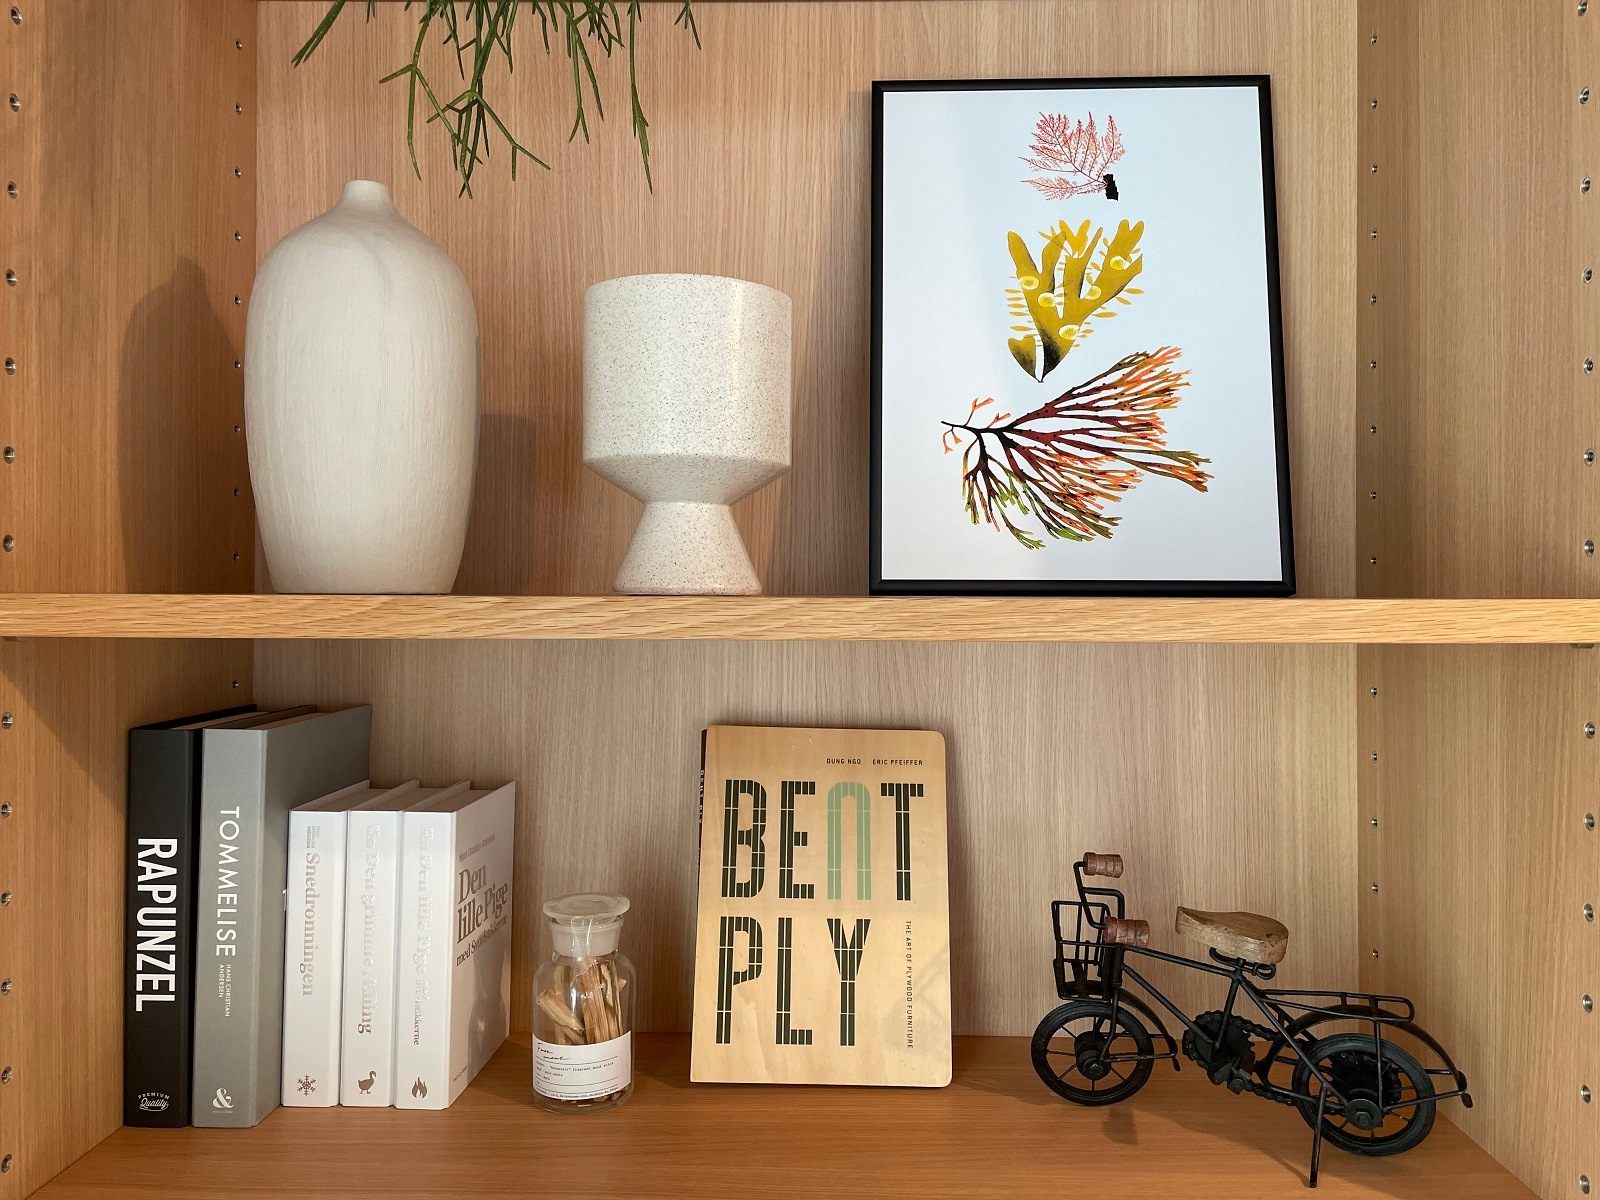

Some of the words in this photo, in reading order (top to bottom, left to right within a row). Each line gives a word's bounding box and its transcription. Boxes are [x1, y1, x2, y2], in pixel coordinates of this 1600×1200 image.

[722, 780, 924, 900] BENT
[216, 806, 240, 956] TOMMELISE
[458, 865, 486, 904] Den
[136, 839, 177, 1012] RAPUNZEL
[300, 852, 320, 996] Snedronningen
[457, 898, 483, 944] lille
[484, 883, 508, 922] Pige
[456, 943, 470, 966] med
[716, 916, 871, 1046] PLY
[906, 954, 912, 962] OF
[139, 1098, 169, 1112] Quality
[212, 1088, 234, 1108] &
